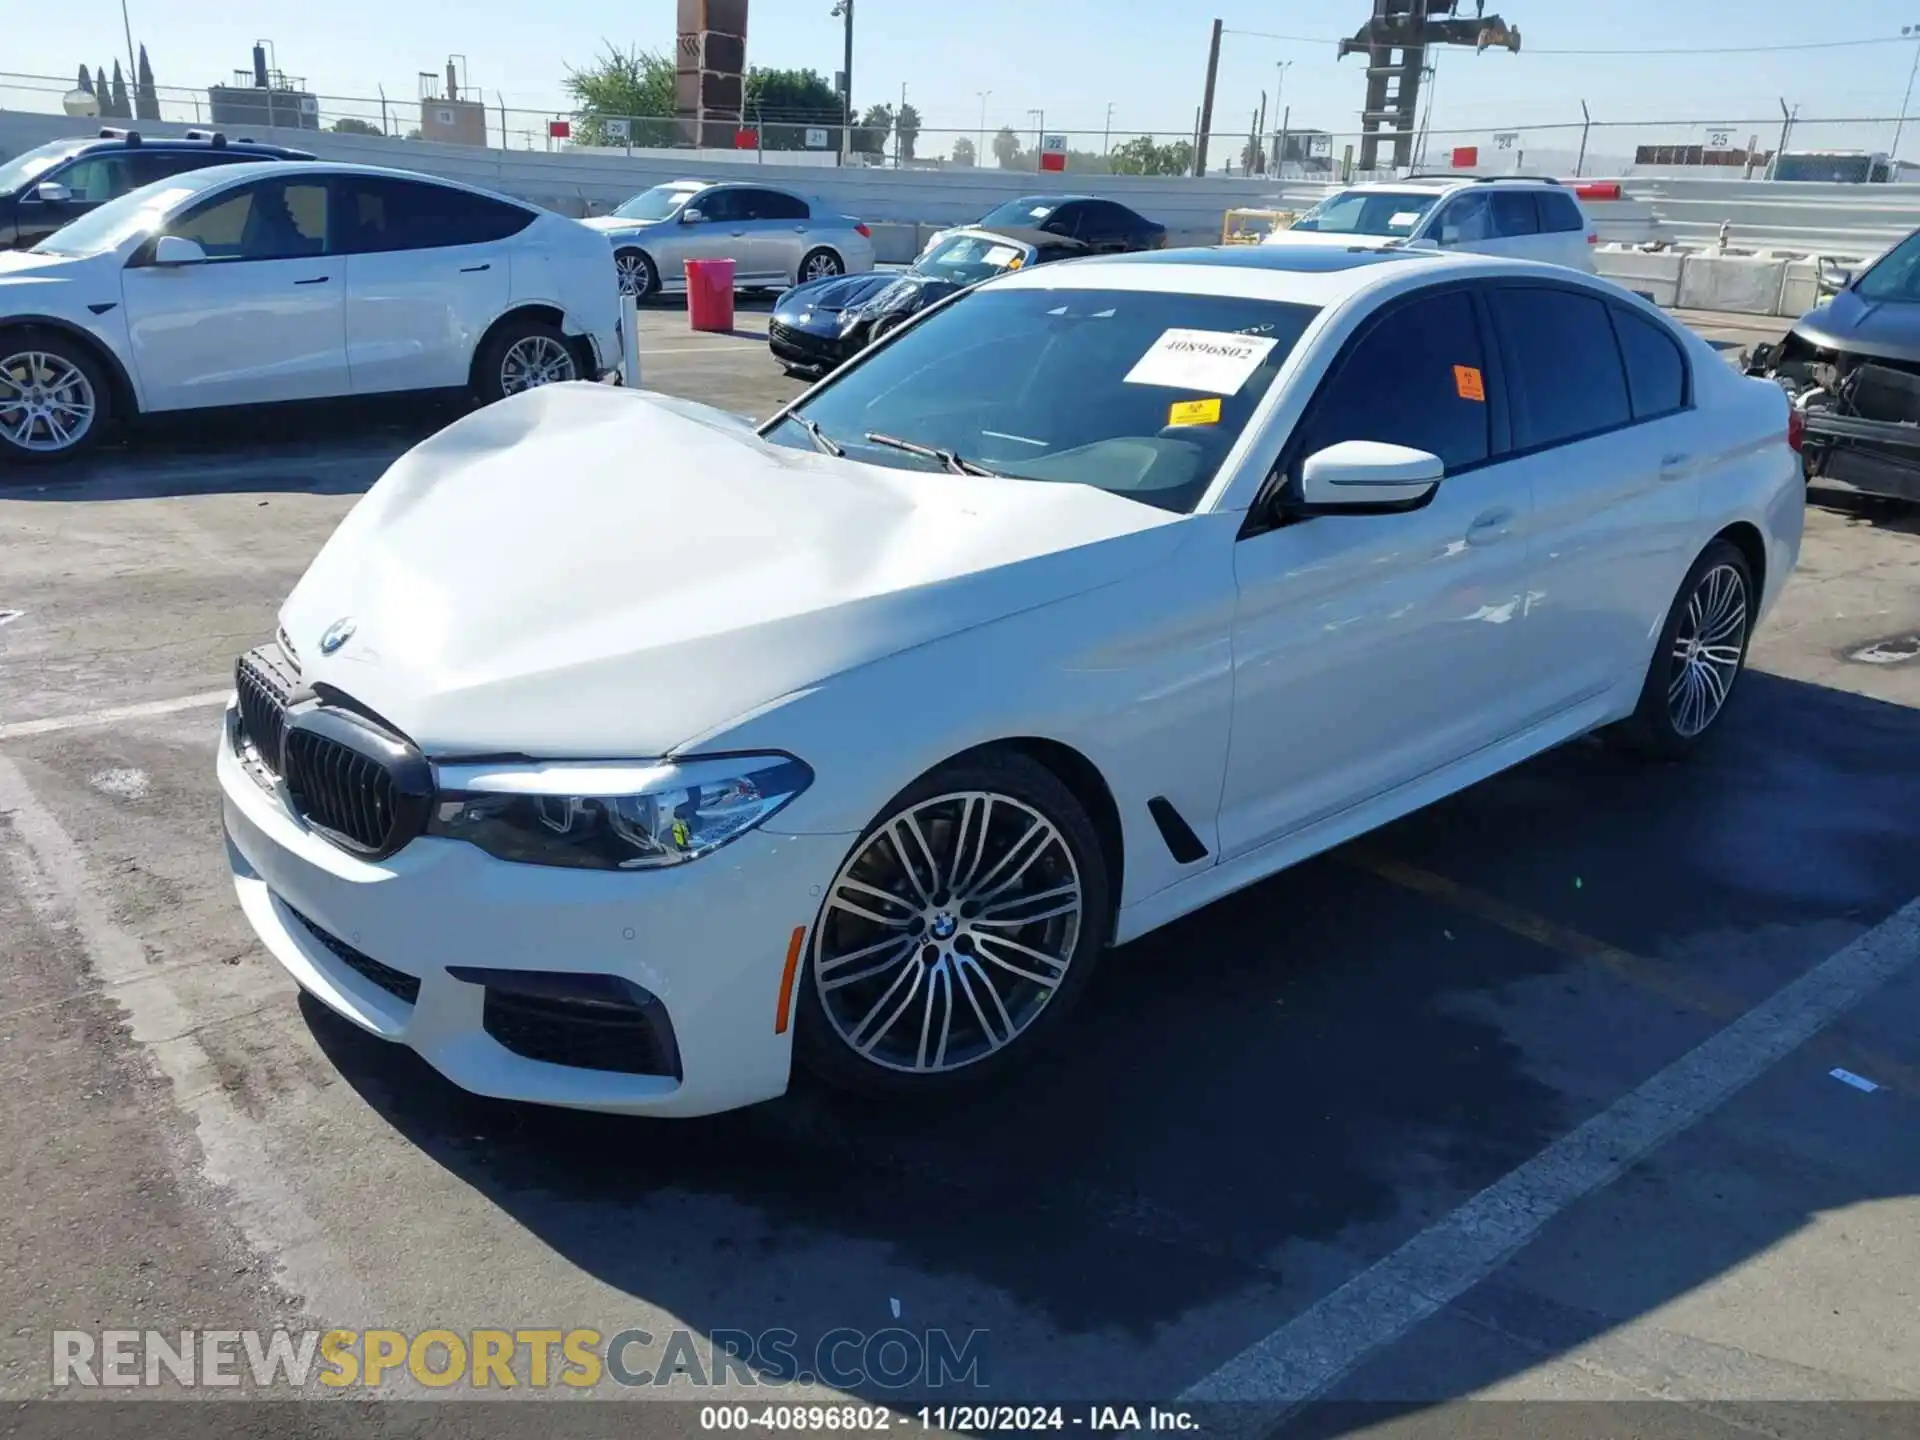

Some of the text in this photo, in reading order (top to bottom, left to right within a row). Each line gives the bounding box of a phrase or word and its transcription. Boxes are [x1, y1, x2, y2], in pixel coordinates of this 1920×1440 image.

[1049, 139, 1062, 149] 22
[1498, 137, 1512, 150] 24
[1711, 133, 1729, 146] 25
[1165, 339, 1253, 360] 40896802
